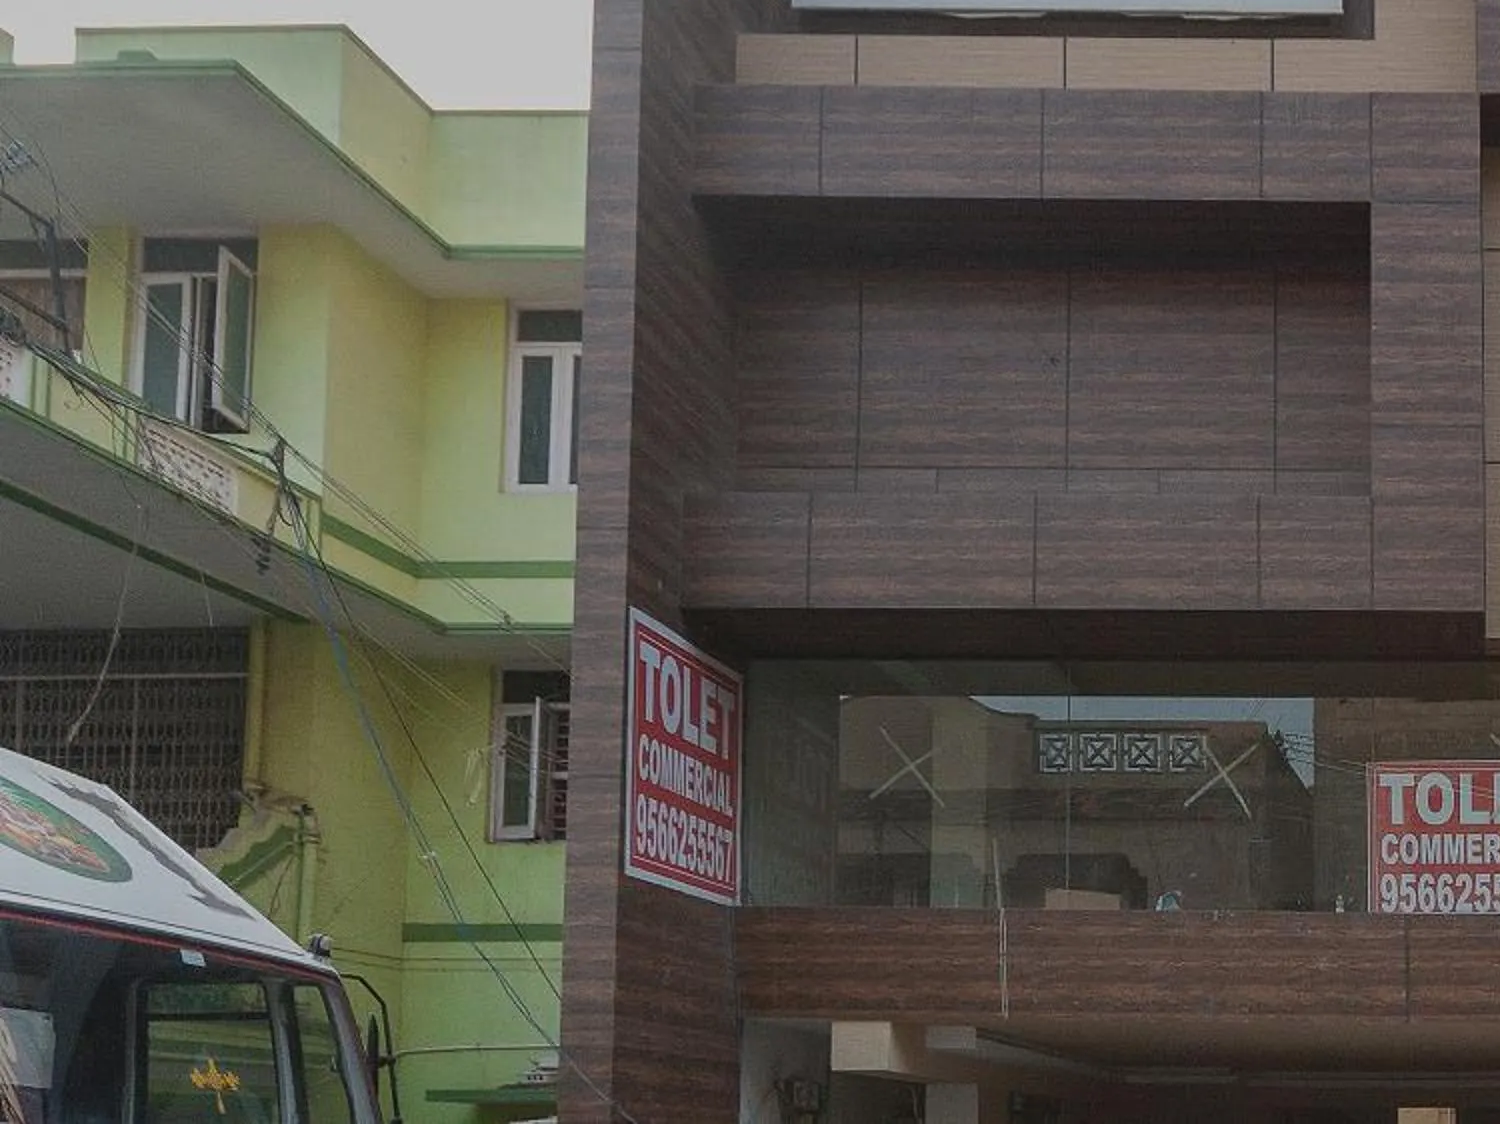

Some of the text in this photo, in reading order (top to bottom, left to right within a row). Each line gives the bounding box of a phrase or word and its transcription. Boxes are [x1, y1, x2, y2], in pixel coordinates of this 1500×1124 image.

[640, 642, 735, 760] TOLET
[638, 734, 733, 817] COMMERCIAL
[637, 793, 733, 883] 9566255567
